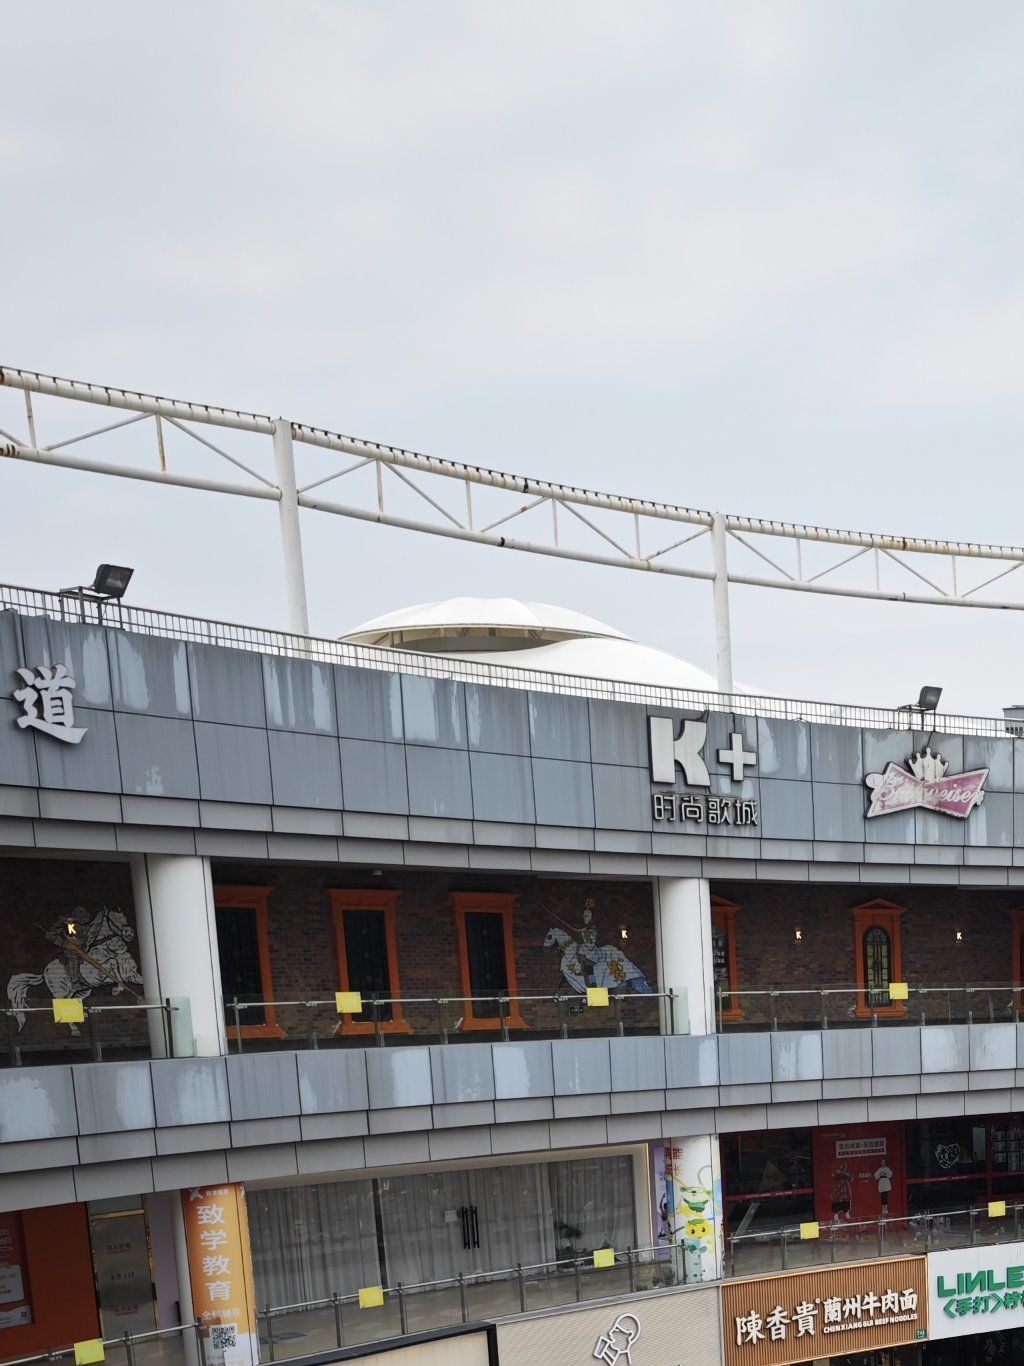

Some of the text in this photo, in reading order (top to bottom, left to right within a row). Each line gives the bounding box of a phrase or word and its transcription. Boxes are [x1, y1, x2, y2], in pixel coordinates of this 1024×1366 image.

[13, 663, 88, 744] 道
[653, 793, 759, 827] 时尚歌城
[68, 923, 77, 935] K
[197, 1204, 232, 1301] 致学教育
[735, 1288, 919, 1347] 陳香貴 蘭州牛肉面
[874, 1316, 890, 1327] BEEF
[889, 1313, 918, 1324] NOODLES
